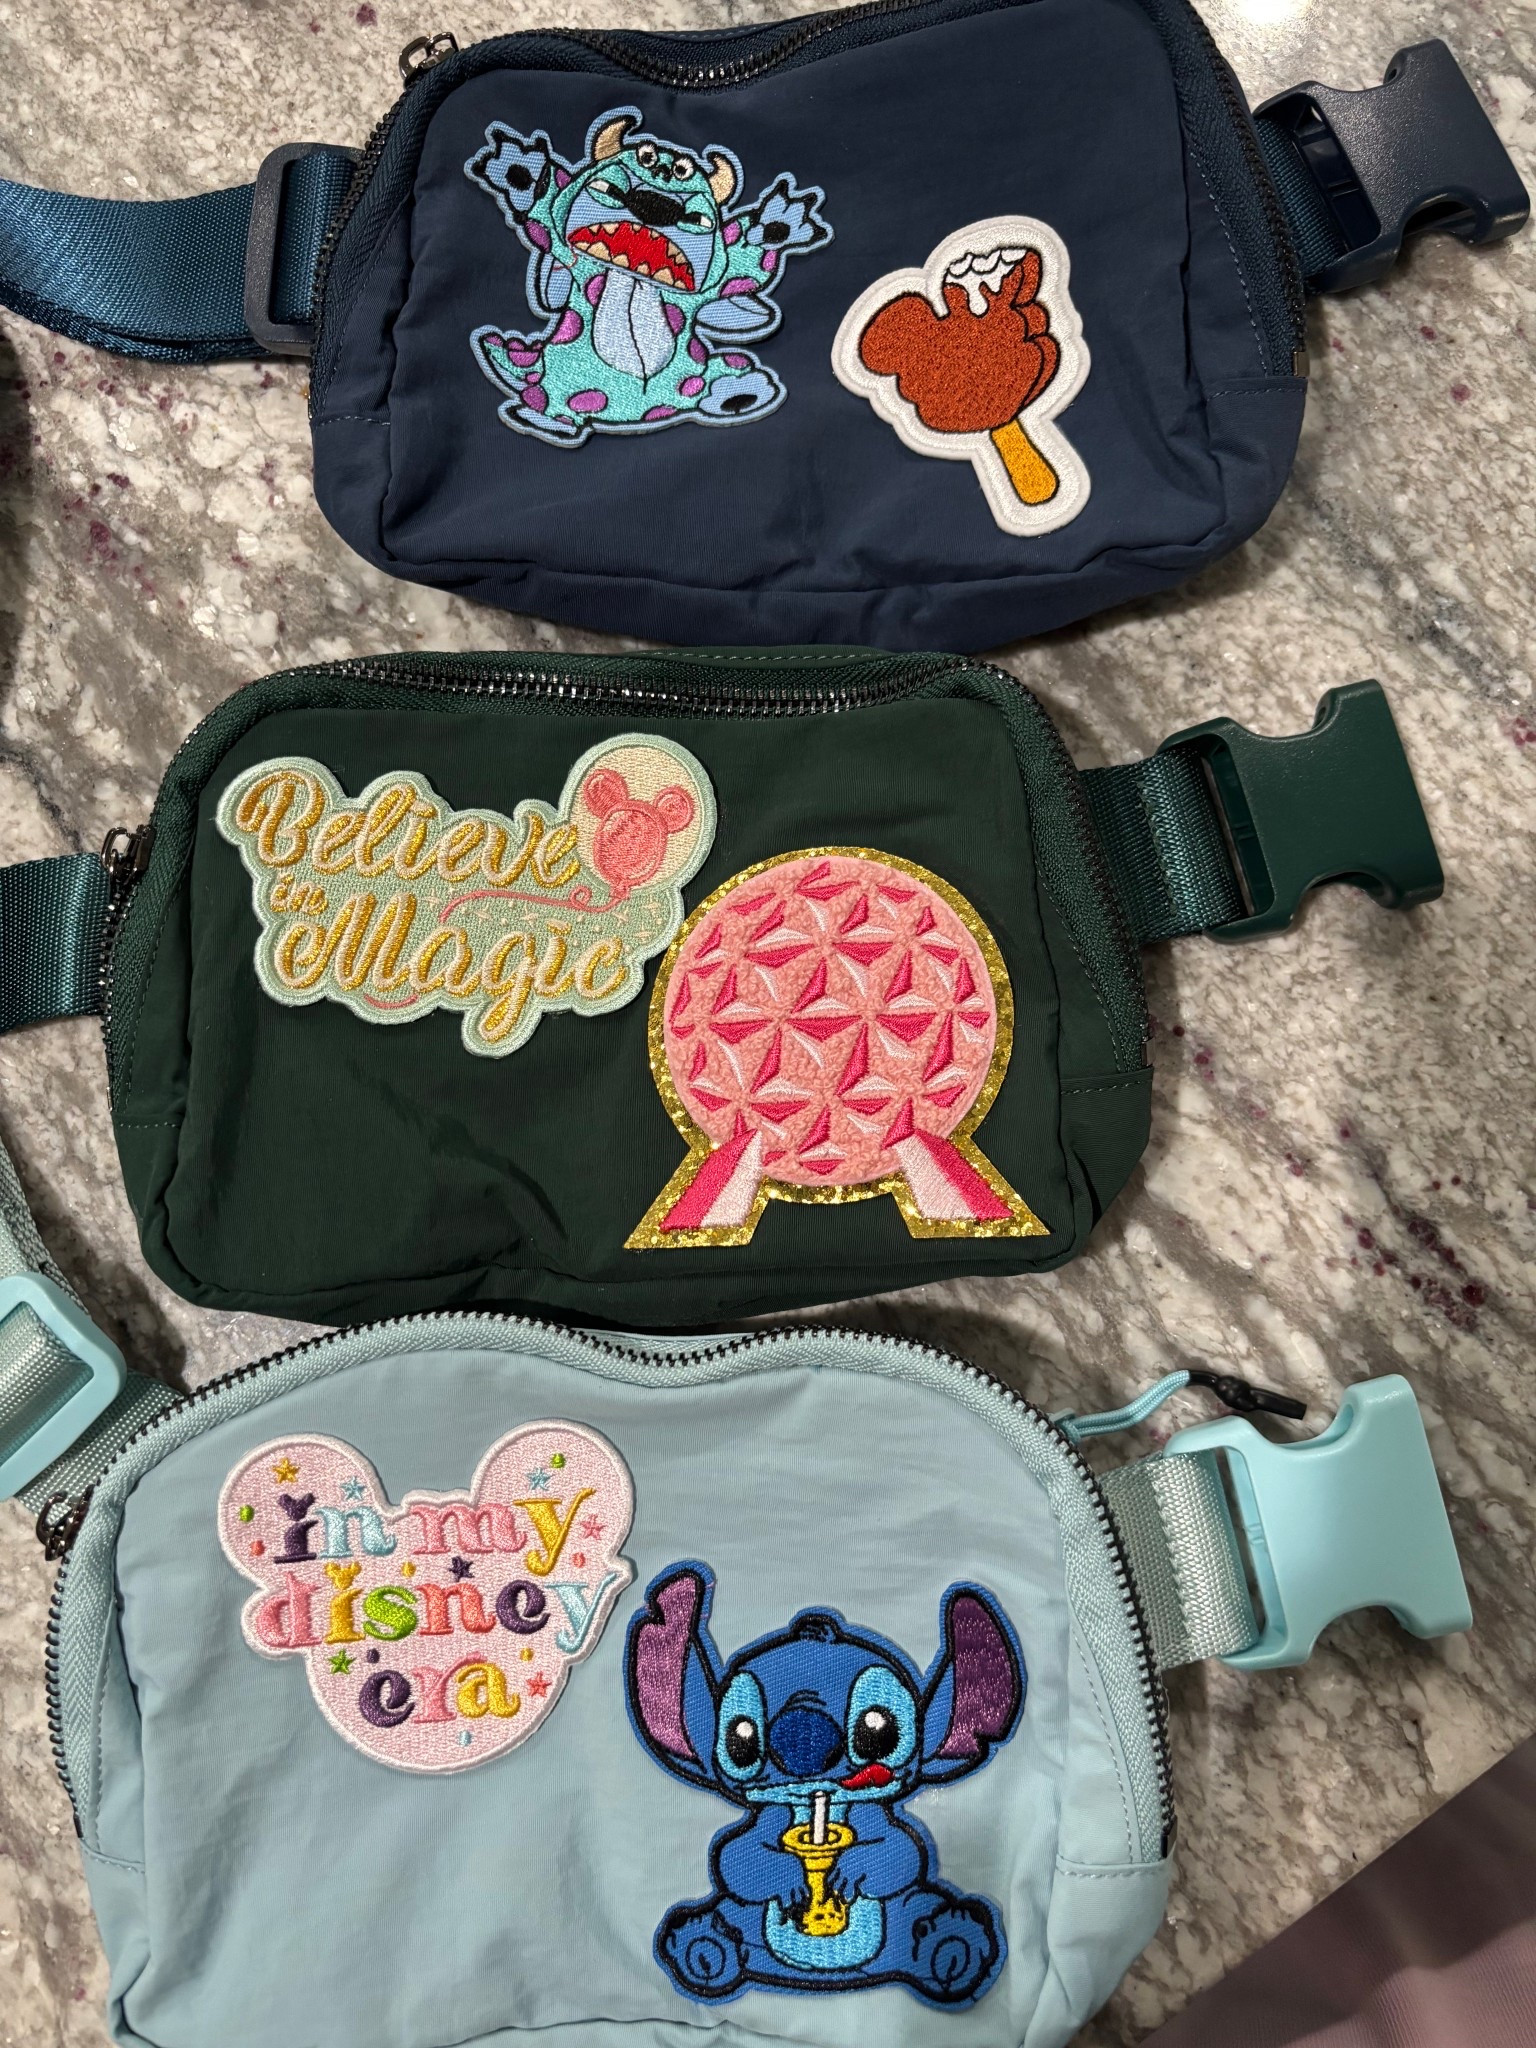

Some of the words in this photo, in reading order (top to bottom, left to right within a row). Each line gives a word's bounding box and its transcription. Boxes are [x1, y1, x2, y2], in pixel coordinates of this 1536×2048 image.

[236, 771, 580, 888] Believe
[269, 872, 327, 915] in
[274, 892, 627, 1044] Magic
[273, 1493, 397, 1564] in
[411, 1487, 597, 1577] my
[255, 1562, 618, 1652] disney
[359, 1652, 521, 1728] era
